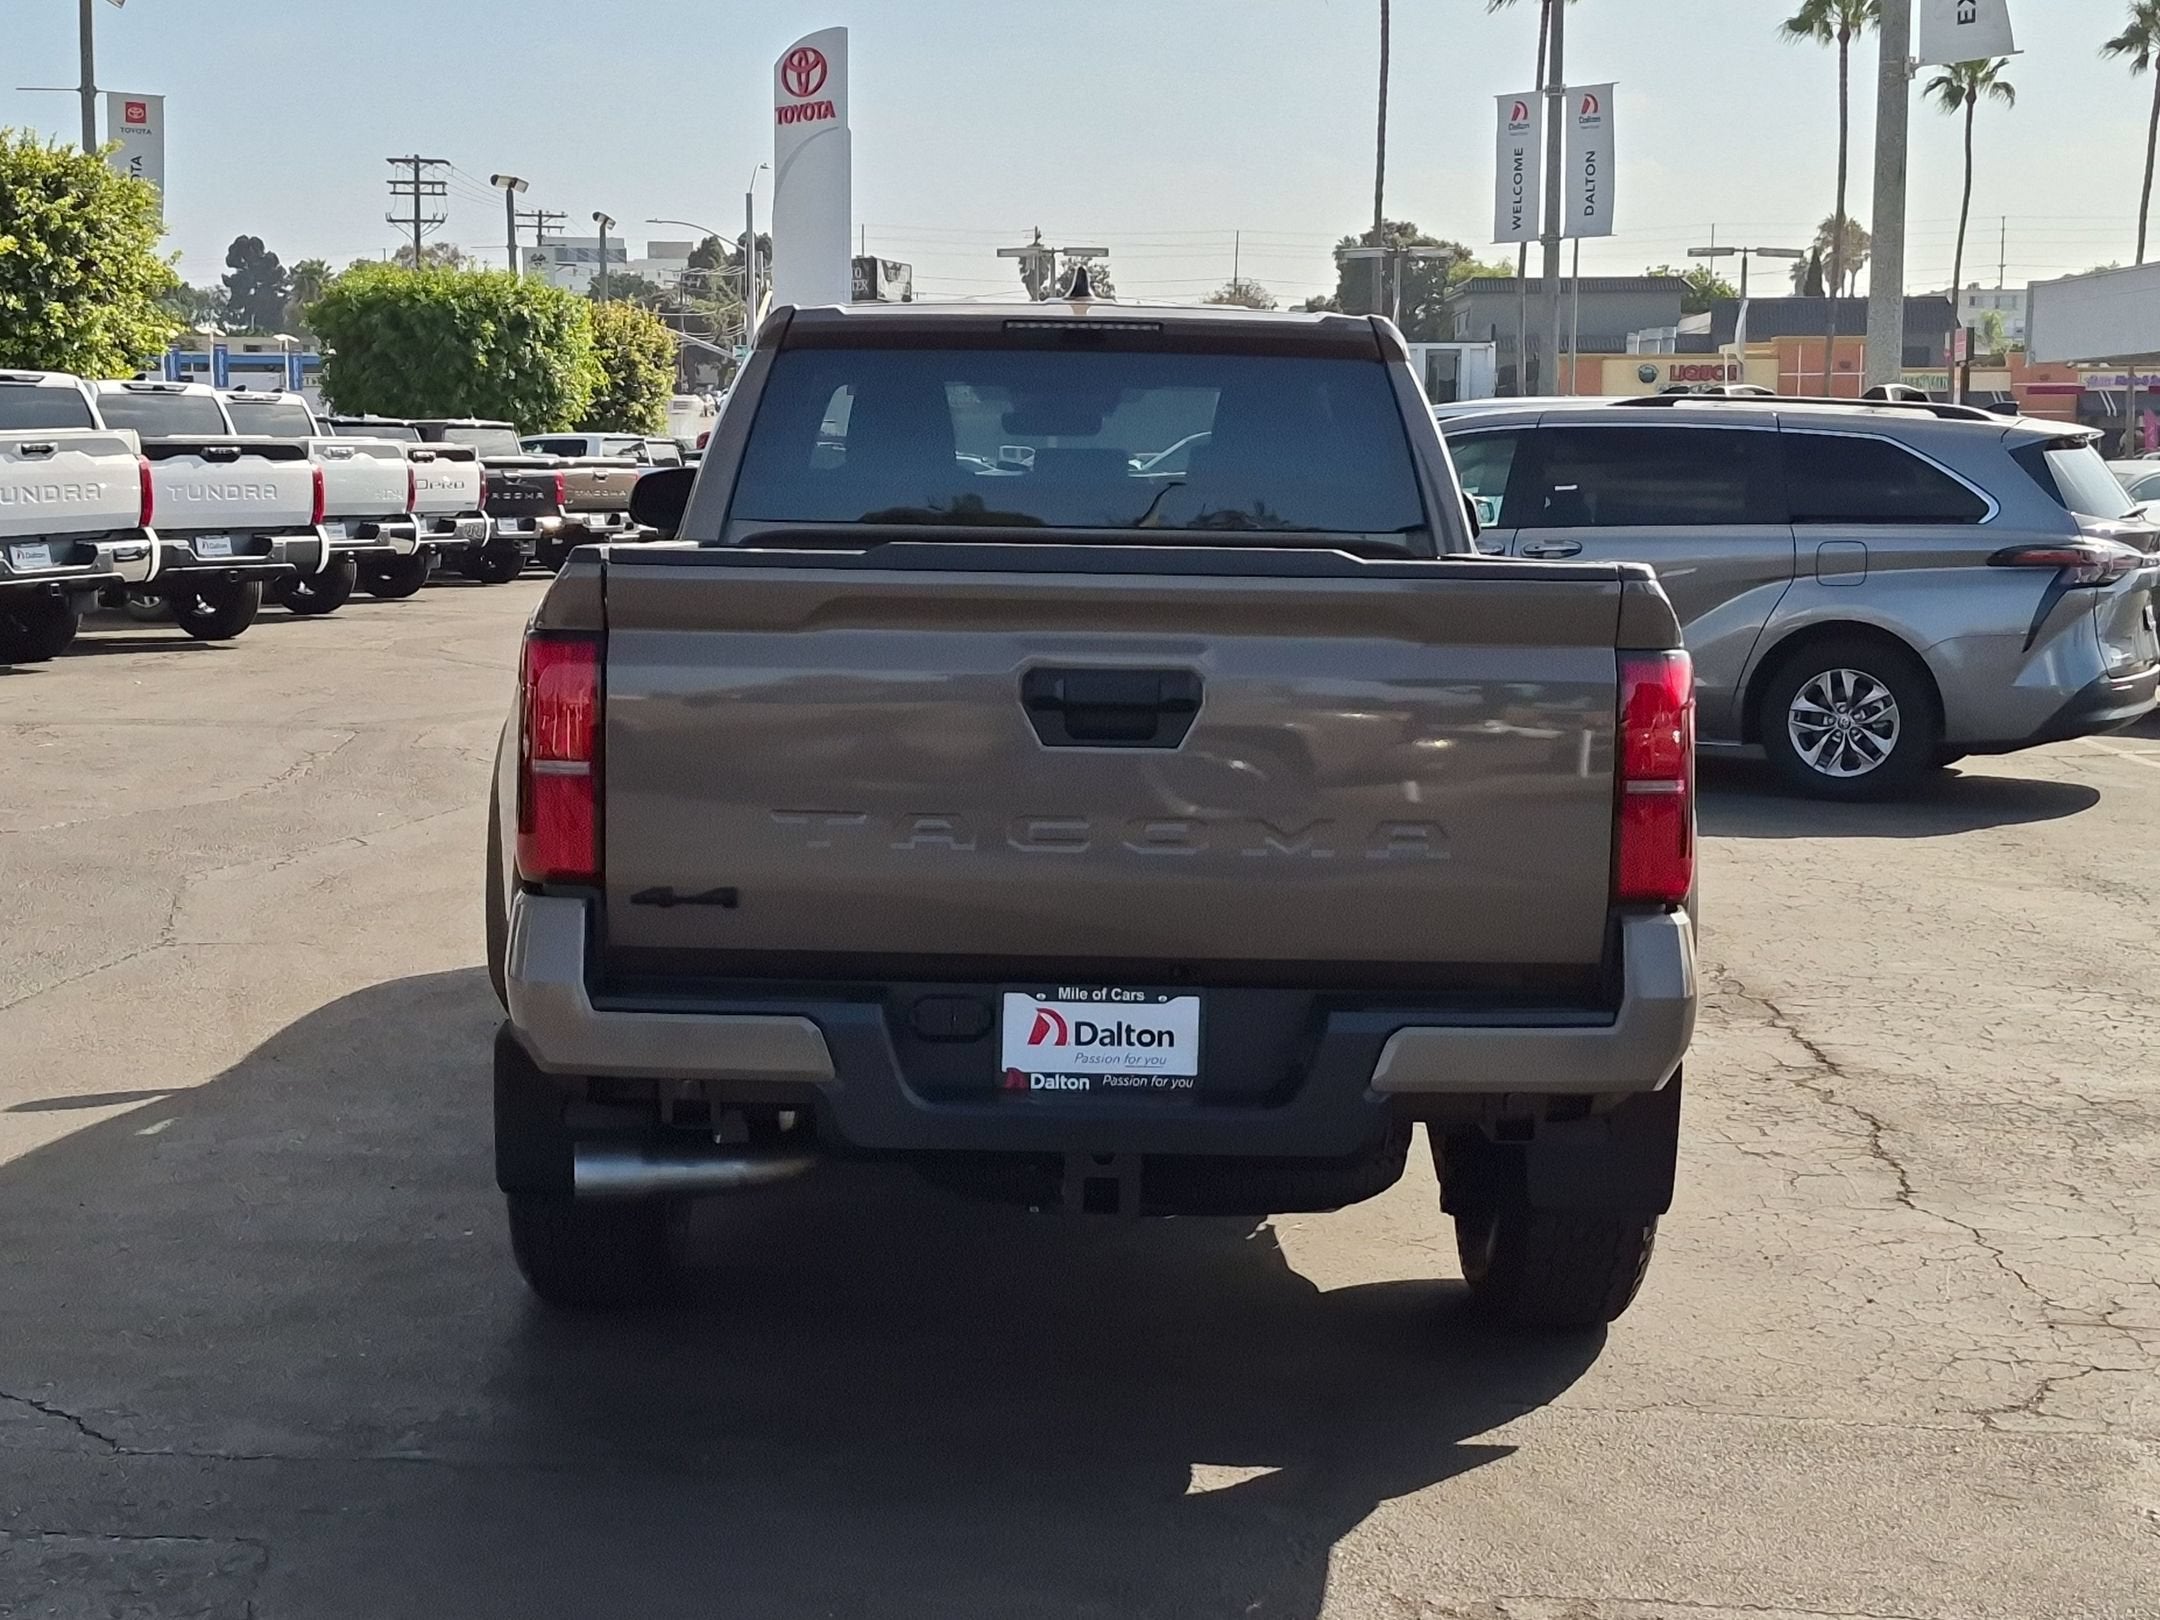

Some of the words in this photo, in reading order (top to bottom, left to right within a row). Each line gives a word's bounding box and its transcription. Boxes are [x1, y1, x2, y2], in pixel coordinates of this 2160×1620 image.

[776, 100, 836, 125] TOYOTA
[120, 127, 152, 135] TOYOTA
[1512, 147, 1524, 230] WELCOME
[1584, 151, 1596, 216] DALTON
[166, 484, 277, 501] TUNDRA
[770, 808, 1451, 858] TACOMA
[1058, 987, 1088, 1000] Mile
[1092, 987, 1108, 1000] of
[1111, 988, 1145, 1001] Cars
[1074, 1021, 1175, 1047] Dalton
[1074, 1052, 1120, 1064] Passion
[1124, 1053, 1142, 1065] for
[1144, 1056, 1167, 1066] you
[1031, 1074, 1090, 1090] Dalton
[1102, 1074, 1148, 1087] Passion
[1150, 1075, 1169, 1087] for
[1170, 1078, 1194, 1090] you
